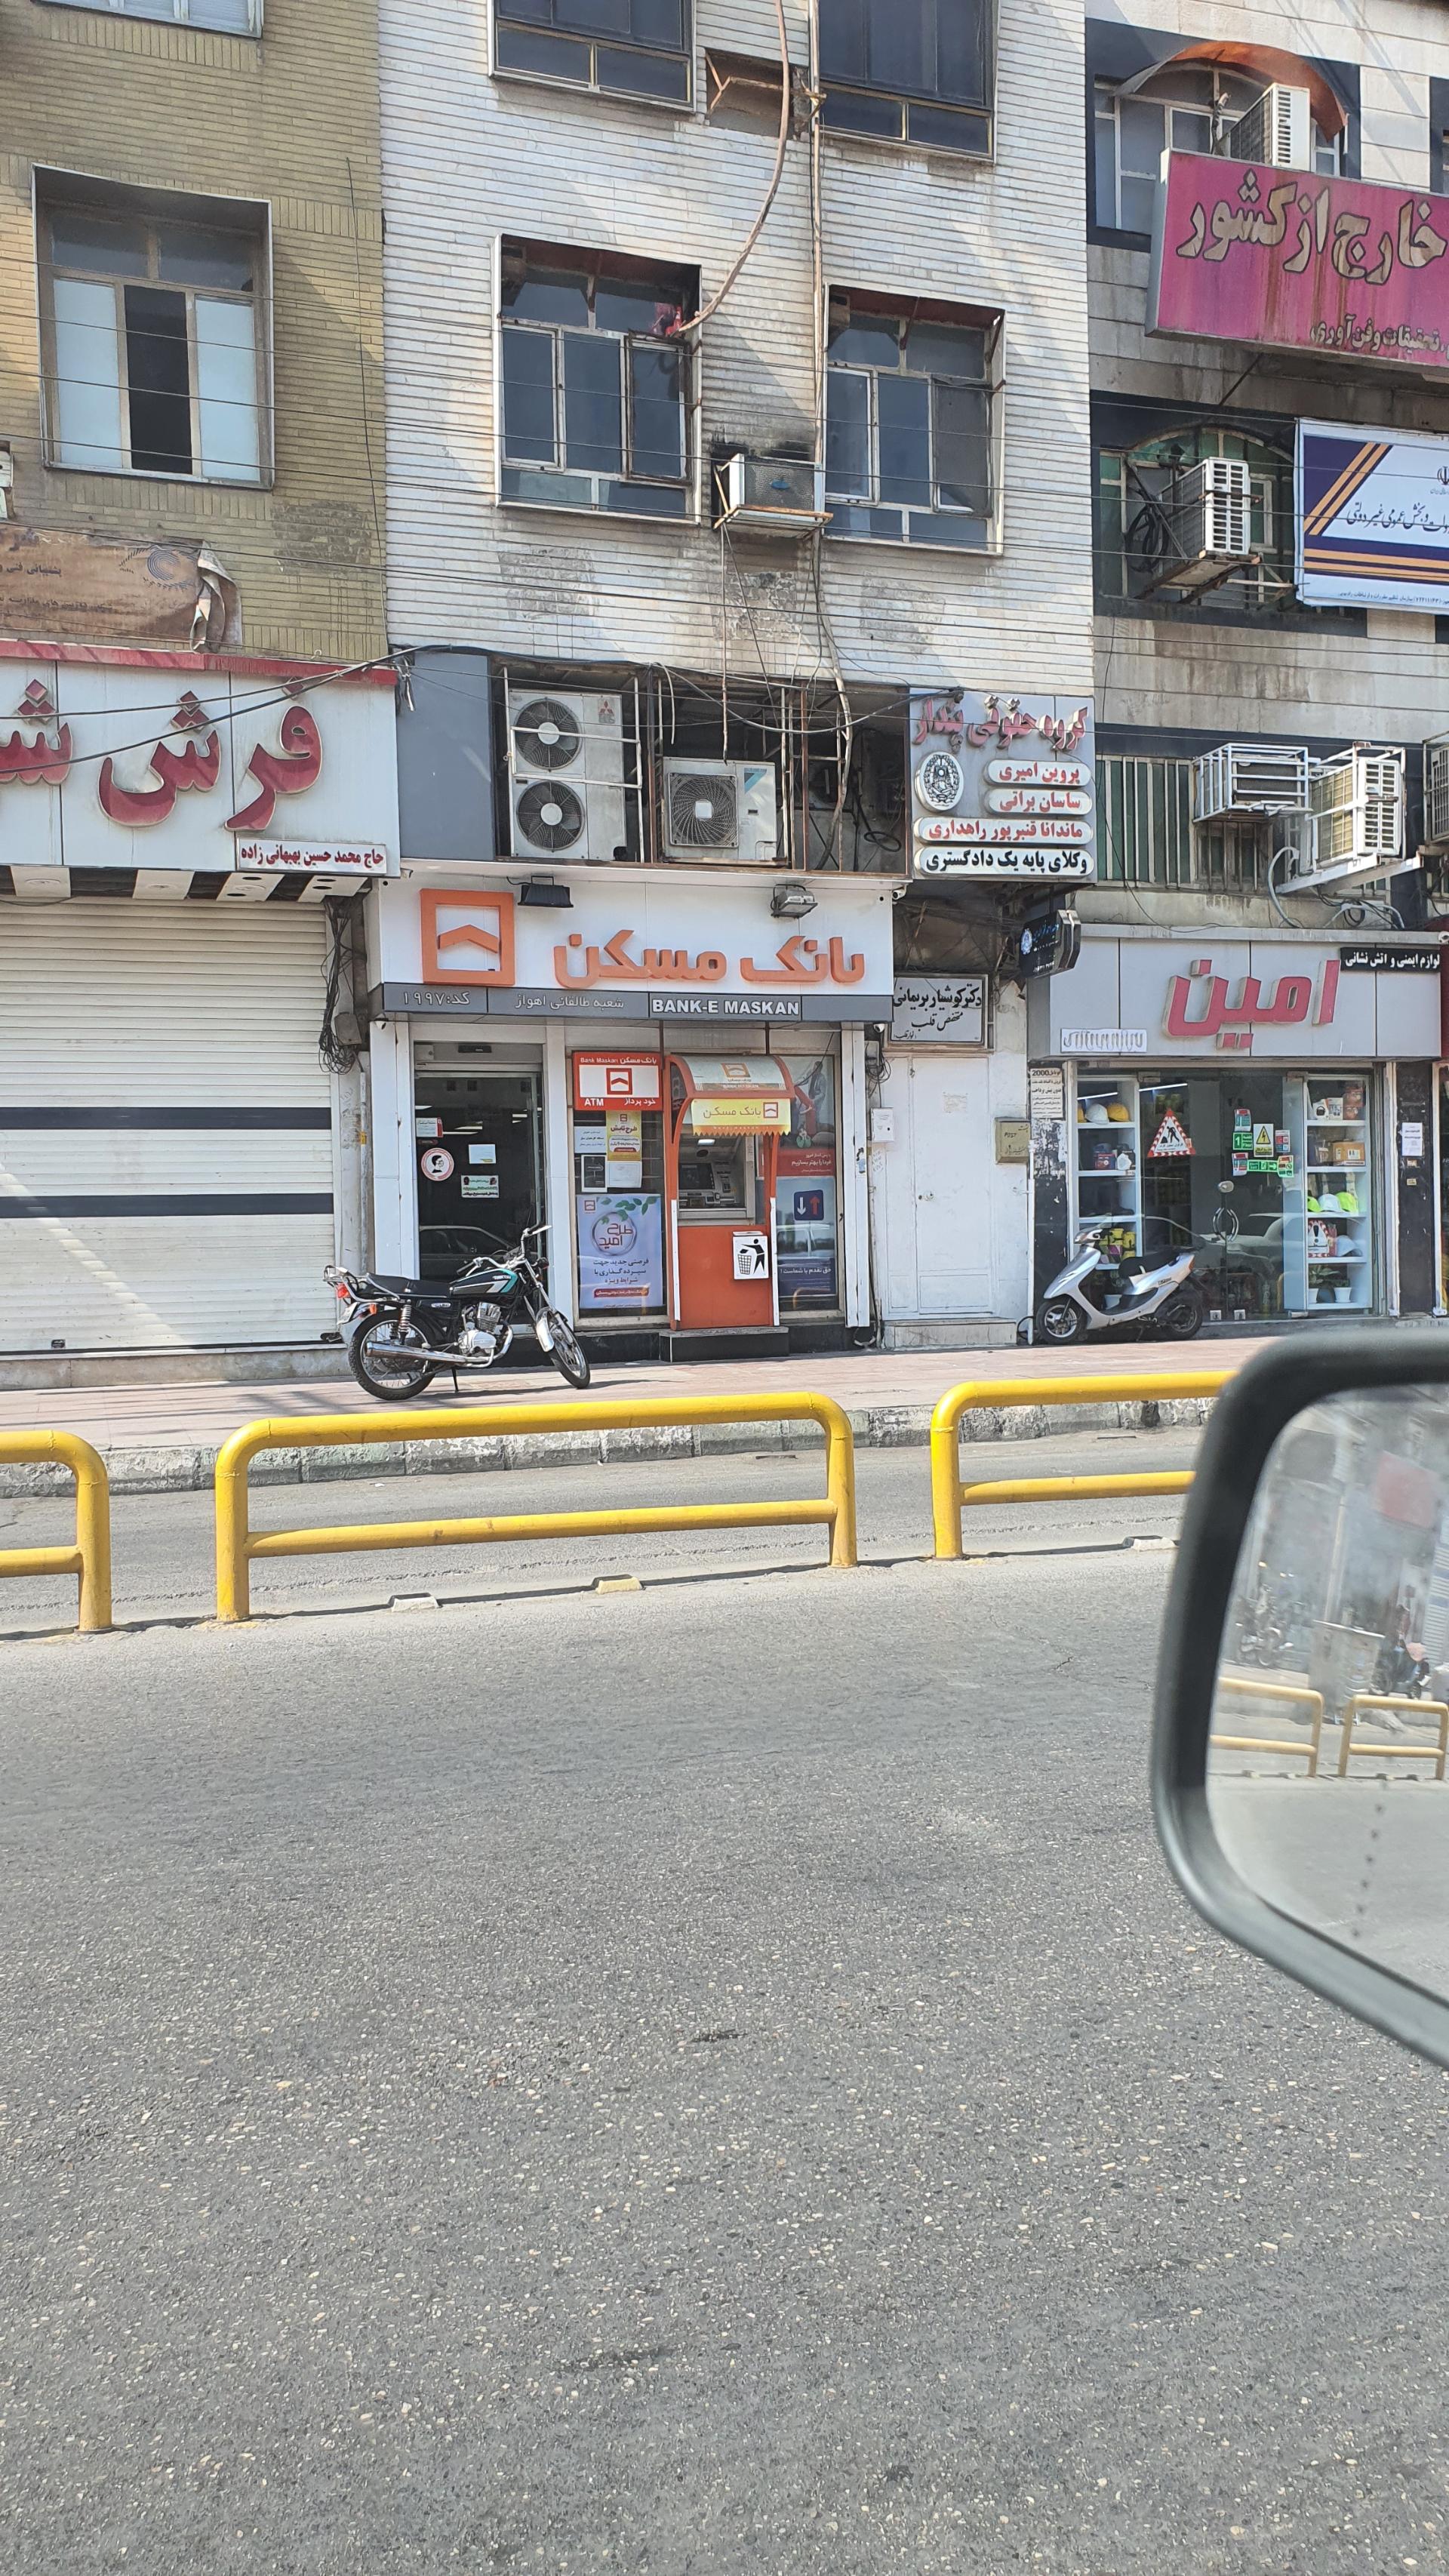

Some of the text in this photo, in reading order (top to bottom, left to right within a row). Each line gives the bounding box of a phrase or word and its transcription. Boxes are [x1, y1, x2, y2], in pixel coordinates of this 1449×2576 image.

[1176, 168, 1447, 286] خارج از کشور
[966, 694, 1038, 750] حقوقی
[98, 677, 323, 831] فرش
[999, 762, 1080, 784] پروین امیری
[999, 791, 1081, 812] ساسان براتی
[928, 820, 987, 841] راهداری
[1040, 822, 1083, 838] ماندانا
[241, 843, 384, 869] حاج محمد حسین بهبهانی زاده
[926, 850, 1087, 874] وکلای پایه یک دادگستری
[553, 929, 866, 989] بانک مسکن
[1345, 952, 1368, 967] نشانی
[1389, 956, 1395, 968] و
[1396, 953, 1419, 968] ایمنی
[1420, 953, 1441, 969] لوازم
[515, 993, 625, 1013] شعبه طالقانی اهواز
[929, 984, 967, 1011] کوشیار
[961, 983, 983, 1008] دکتر
[1163, 959, 1341, 1048] امین
[652, 999, 800, 1016] BANK-E MASKAN
[911, 1013, 937, 1032] قلب
[624, 1097, 656, 1106] خود پرداز
[703, 1106, 761, 1119] بانک مسکن
[625, 1125, 638, 1134] طرح
[607, 1223, 633, 1236] طرح
[598, 1235, 623, 1249] امید
[628, 1257, 649, 1266] فرصتی
